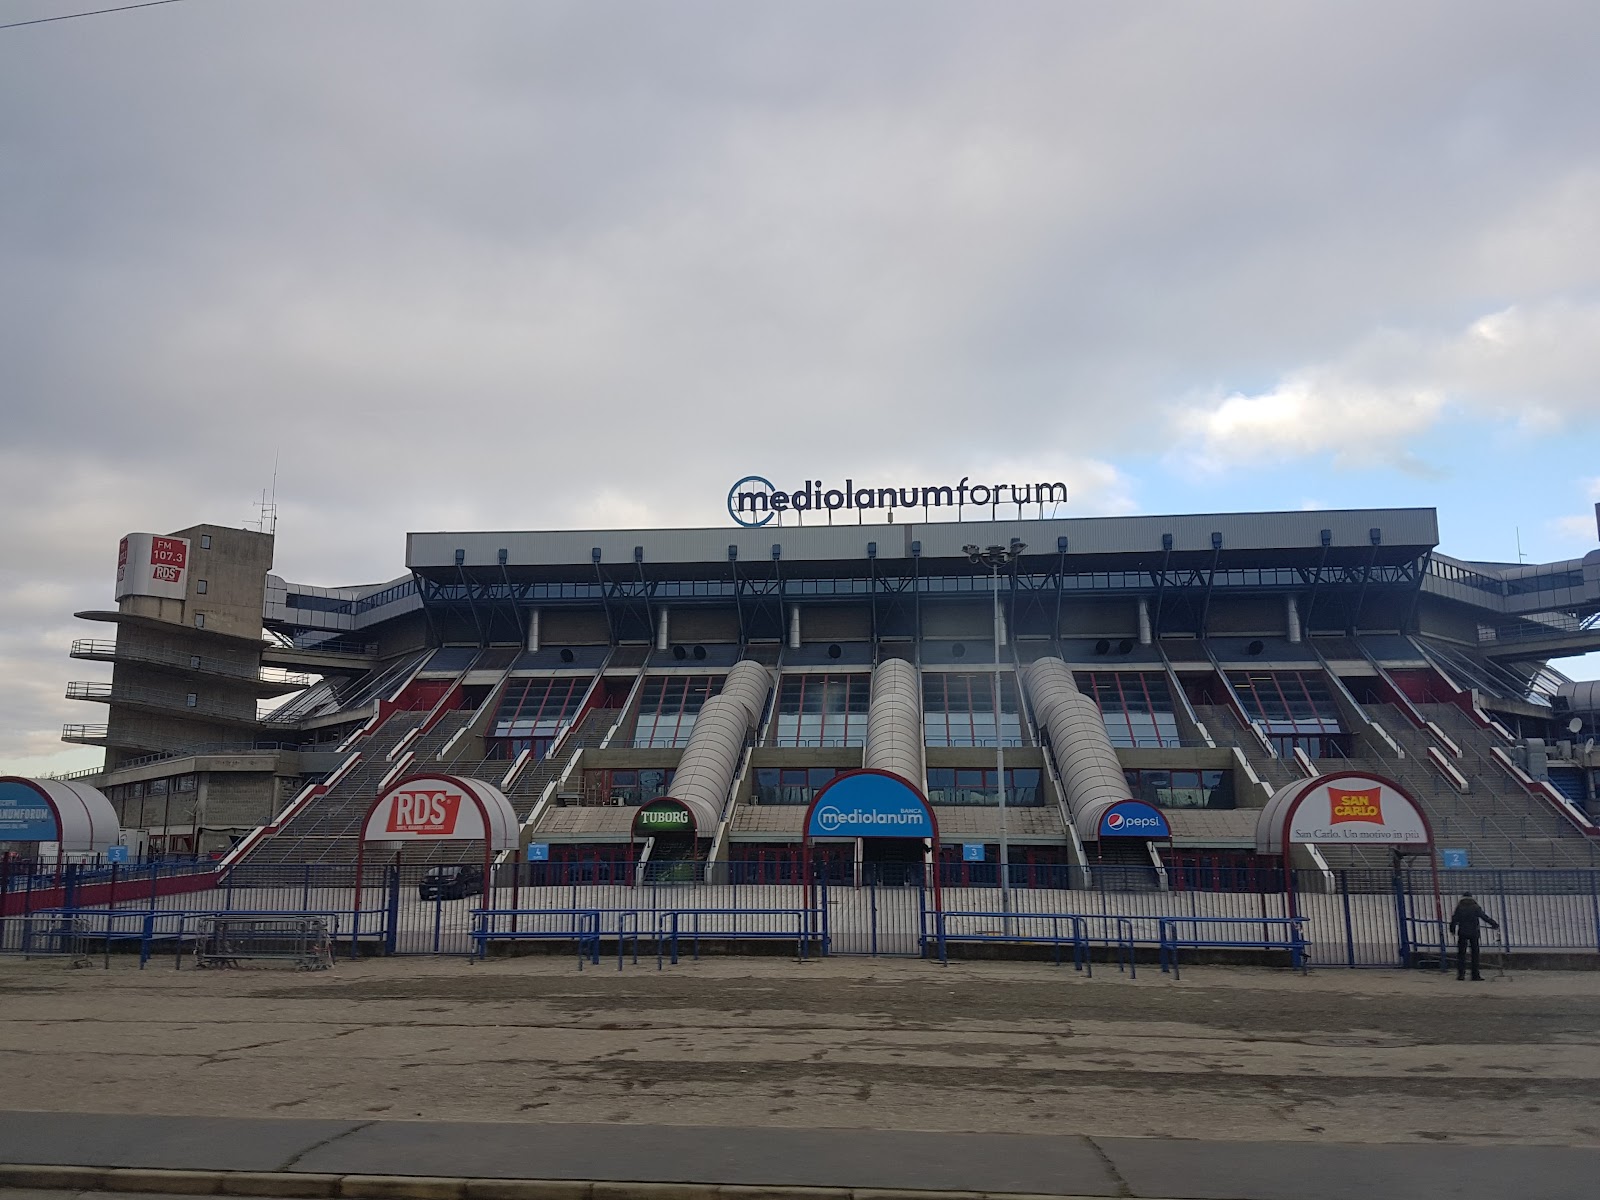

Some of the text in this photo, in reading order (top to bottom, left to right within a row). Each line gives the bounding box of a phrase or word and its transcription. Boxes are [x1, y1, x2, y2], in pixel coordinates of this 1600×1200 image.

[738, 476, 1068, 512] mediolanumforum
[157, 540, 172, 549] FM
[153, 550, 183, 562] 107.3
[156, 565, 176, 579] RDS
[1341, 795, 1369, 806] SAN
[397, 792, 447, 826] RDS
[1334, 805, 1379, 816] CARLO
[641, 810, 689, 824] TUBORG
[822, 808, 923, 825] mediolanum
[1126, 816, 1159, 828] pepsi
[1295, 829, 1312, 839] San
[1344, 829, 1358, 839] Un
[1360, 829, 1392, 839] motivo
[1393, 829, 1403, 839] in
